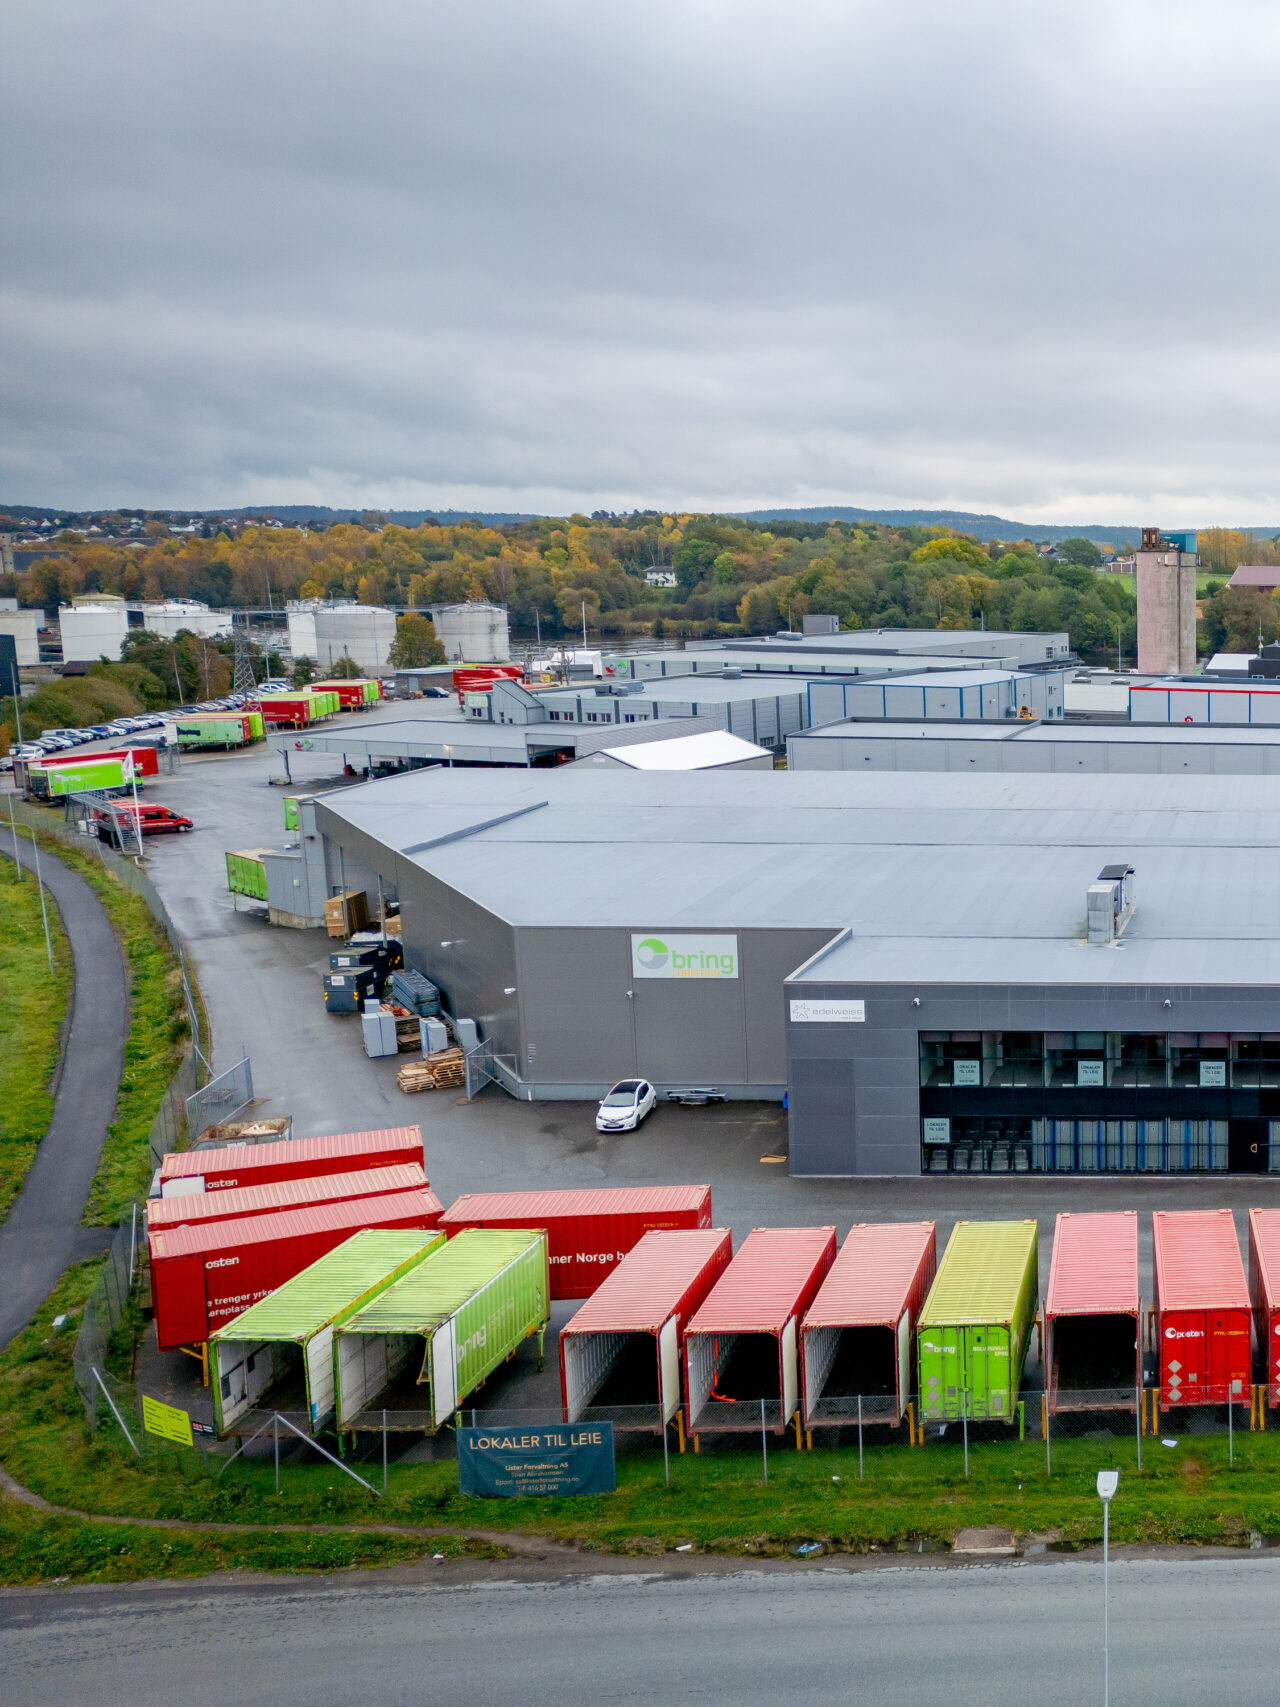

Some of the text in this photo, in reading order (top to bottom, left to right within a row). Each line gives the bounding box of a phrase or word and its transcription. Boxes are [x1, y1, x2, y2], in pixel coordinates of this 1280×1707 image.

[671, 950, 734, 975] bring
[206, 1178, 238, 1189] osten
[205, 1256, 240, 1269] osten
[548, 1254, 573, 1264] nner
[576, 1252, 613, 1264] Norge
[214, 1293, 251, 1305] trenger
[252, 1289, 275, 1299] yrke
[1176, 1330, 1204, 1339] posten
[933, 1346, 956, 1354] bring
[469, 1432, 603, 1450] LOKALER TIL LEIE
[523, 1463, 559, 1471] Forvaltning
